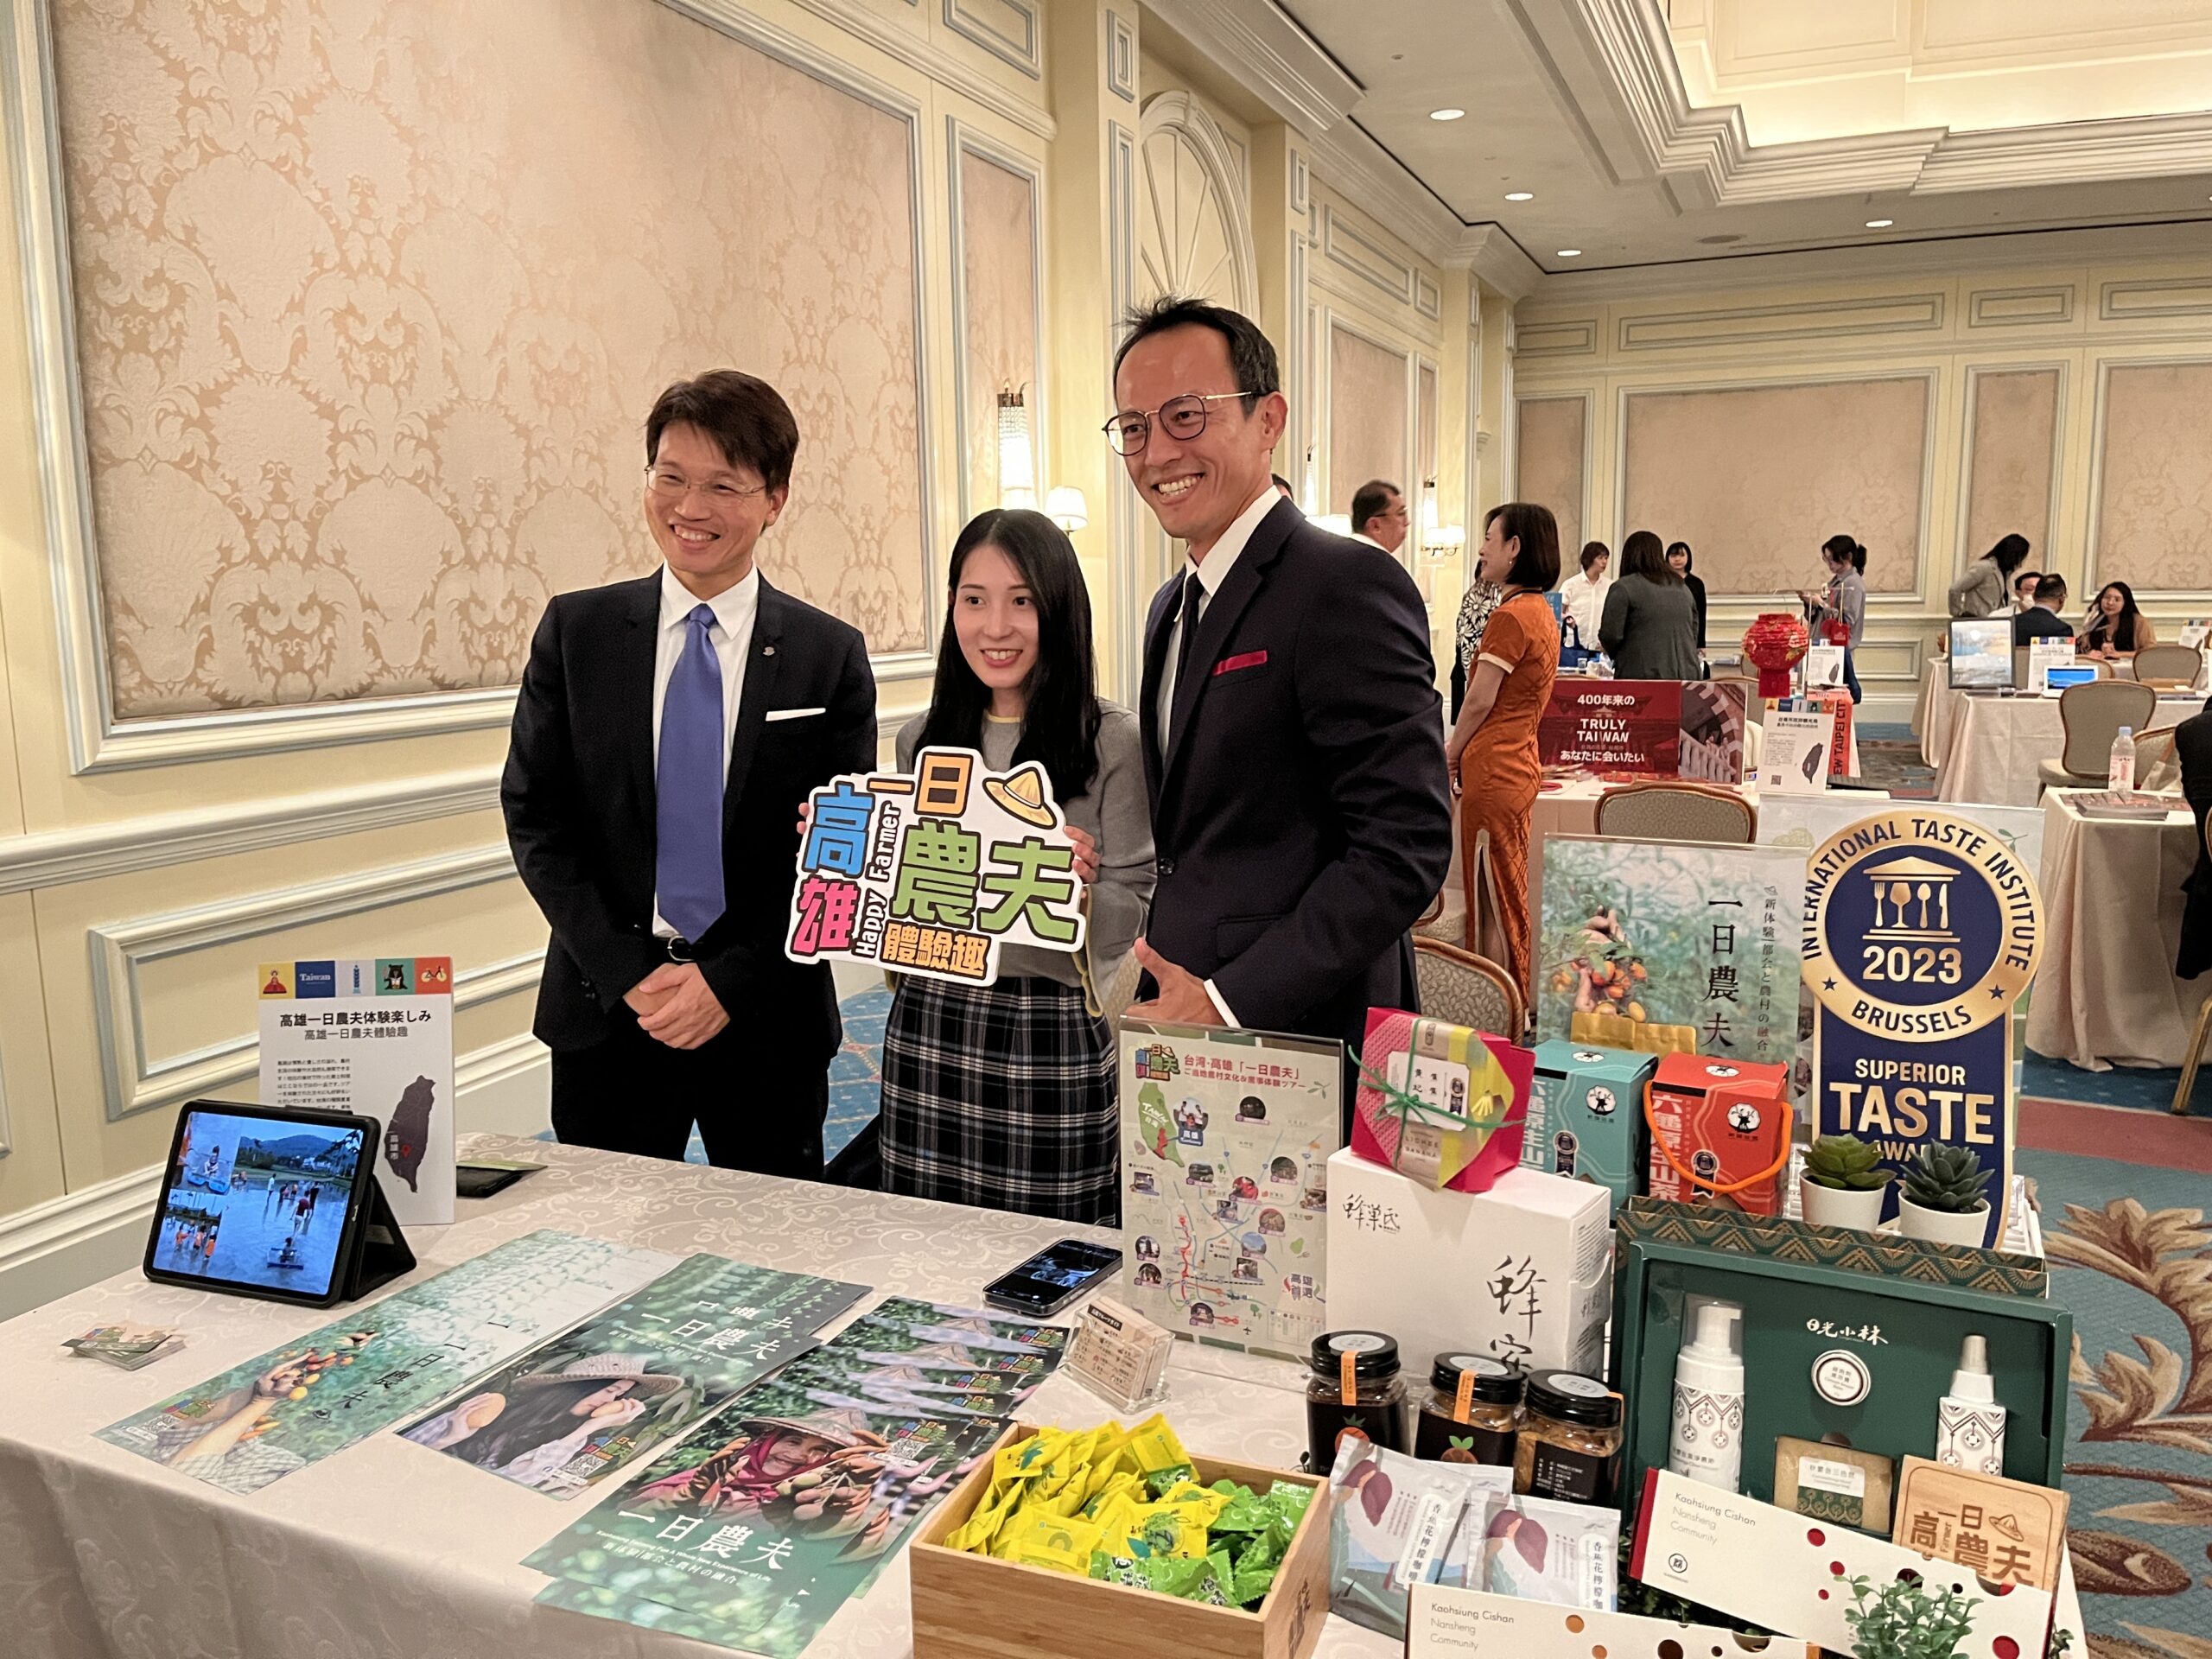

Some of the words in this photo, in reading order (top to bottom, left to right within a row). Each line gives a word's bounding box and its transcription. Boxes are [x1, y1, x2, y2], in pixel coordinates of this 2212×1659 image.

[1577, 694, 1635, 706] 400年来の
[1836, 699, 1847, 718] CIT
[1577, 730, 1630, 743] TAIWAN
[1580, 719, 1626, 730] TRULY
[1834, 721, 1845, 754] TAIPEI
[1560, 750, 1645, 762] あなたに会いたい
[867, 751, 974, 817] 一日
[866, 801, 901, 881] Farmer
[790, 781, 875, 954] 高雄
[889, 818, 1078, 944] 農夫
[1802, 821, 1901, 960] INTERNATIONAL
[1911, 819, 1986, 856] TASTE
[1984, 852, 2036, 971] INSTITUTE
[854, 889, 887, 957] Happy
[880, 921, 992, 980] 體驗趣
[1862, 945, 1961, 984] 2023
[1700, 899, 1744, 1048] 一日農夫
[280, 1010, 431, 1027] 高雄一日農夫体験楽しみ
[1852, 1000, 1972, 1033] BRUSSELS
[1855, 1058, 1966, 1085] SUPERIOR
[1828, 1082, 1994, 1144] TASTE
[641, 1313, 780, 1360] 一日農夫
[1673, 1506, 1717, 1530] Nansheng
[1675, 1492, 1721, 1516] Kaohsiung
[1724, 1509, 1756, 1526] Cishan
[618, 1510, 794, 1570] 一日農夫
[1670, 1520, 1717, 1545] Community
[1430, 1618, 1476, 1637] Nansheng
[1431, 1603, 1479, 1620] Kaohsiung
[1482, 1611, 1515, 1624] Cishan
[1430, 1633, 1478, 1652] Community
